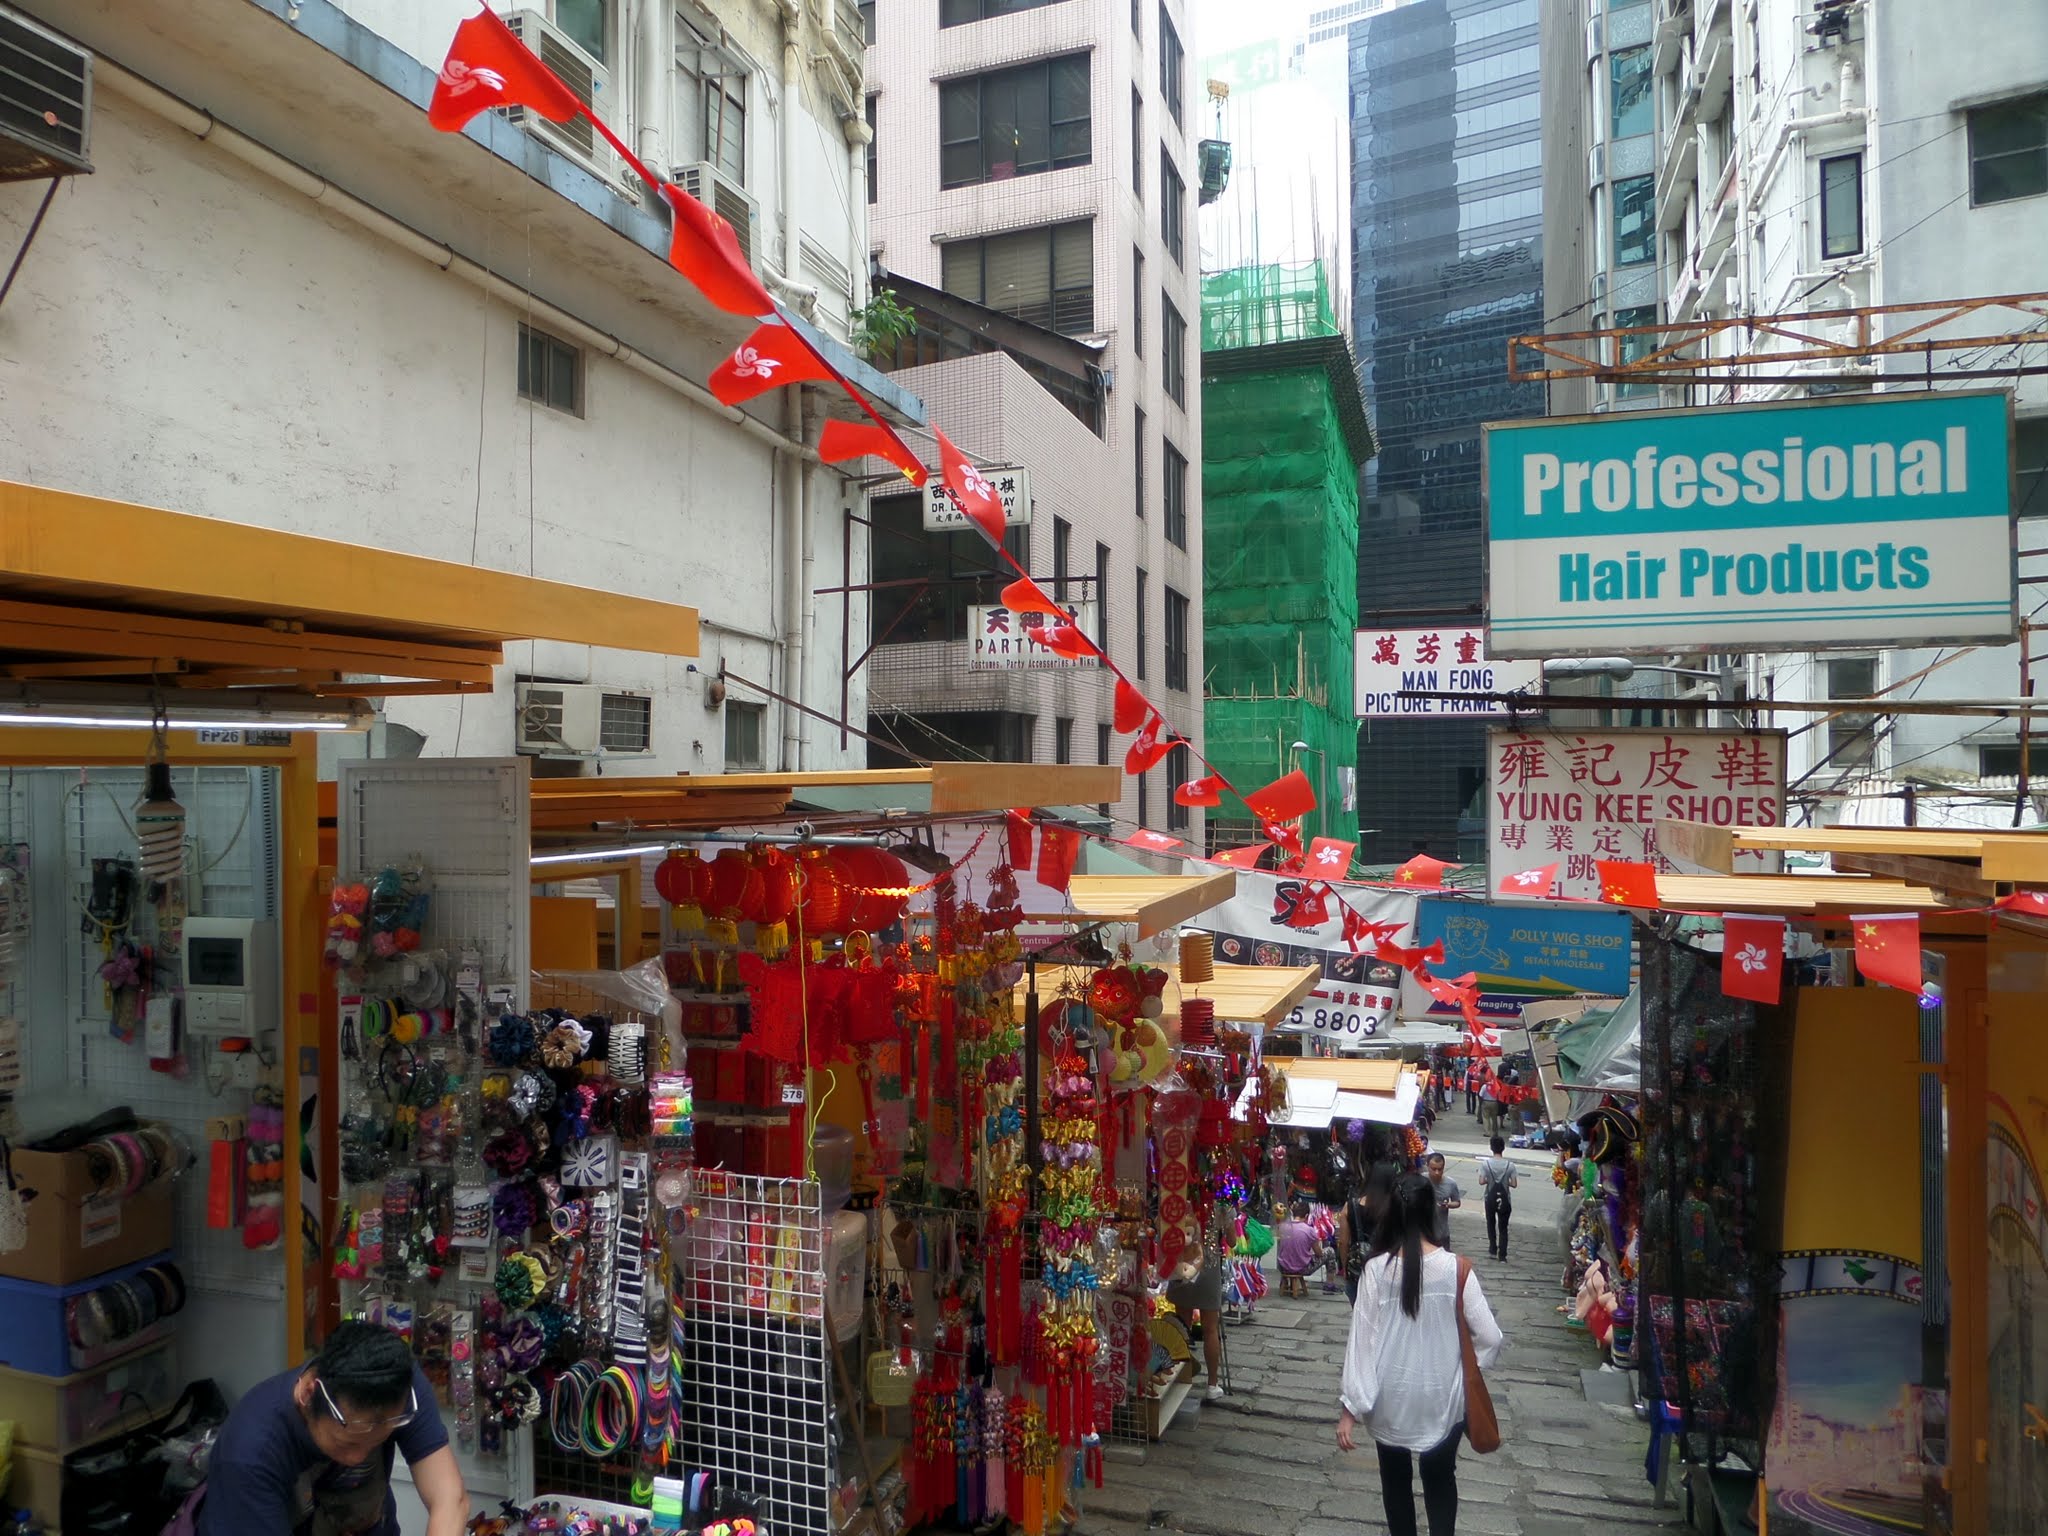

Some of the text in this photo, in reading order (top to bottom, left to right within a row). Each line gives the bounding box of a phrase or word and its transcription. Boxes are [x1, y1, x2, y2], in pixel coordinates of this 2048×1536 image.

[1523, 426, 1968, 516] Professional
[932, 502, 948, 512] DR.
[1559, 542, 1929, 603] Hair Products
[1372, 632, 1497, 665] 萬芳畫
[1006, 659, 1025, 669] Party
[1402, 669, 1493, 691] MAN FONG
[1365, 692, 1432, 713] PICTURE
[1441, 690, 1497, 712] FRAME
[201, 730, 239, 742] FP26
[1496, 734, 1775, 791] 雍記皮鞋
[1497, 792, 1776, 826] YUNG KEE SHOES
[1018, 936, 1052, 946] Central,
[1511, 928, 1623, 947] JOLLY WIG SHOP
[1524, 956, 1605, 970] RETAIL WHOLESALE
[1477, 1000, 1514, 1010] Imaging
[1313, 1008, 1378, 1036] 8803
